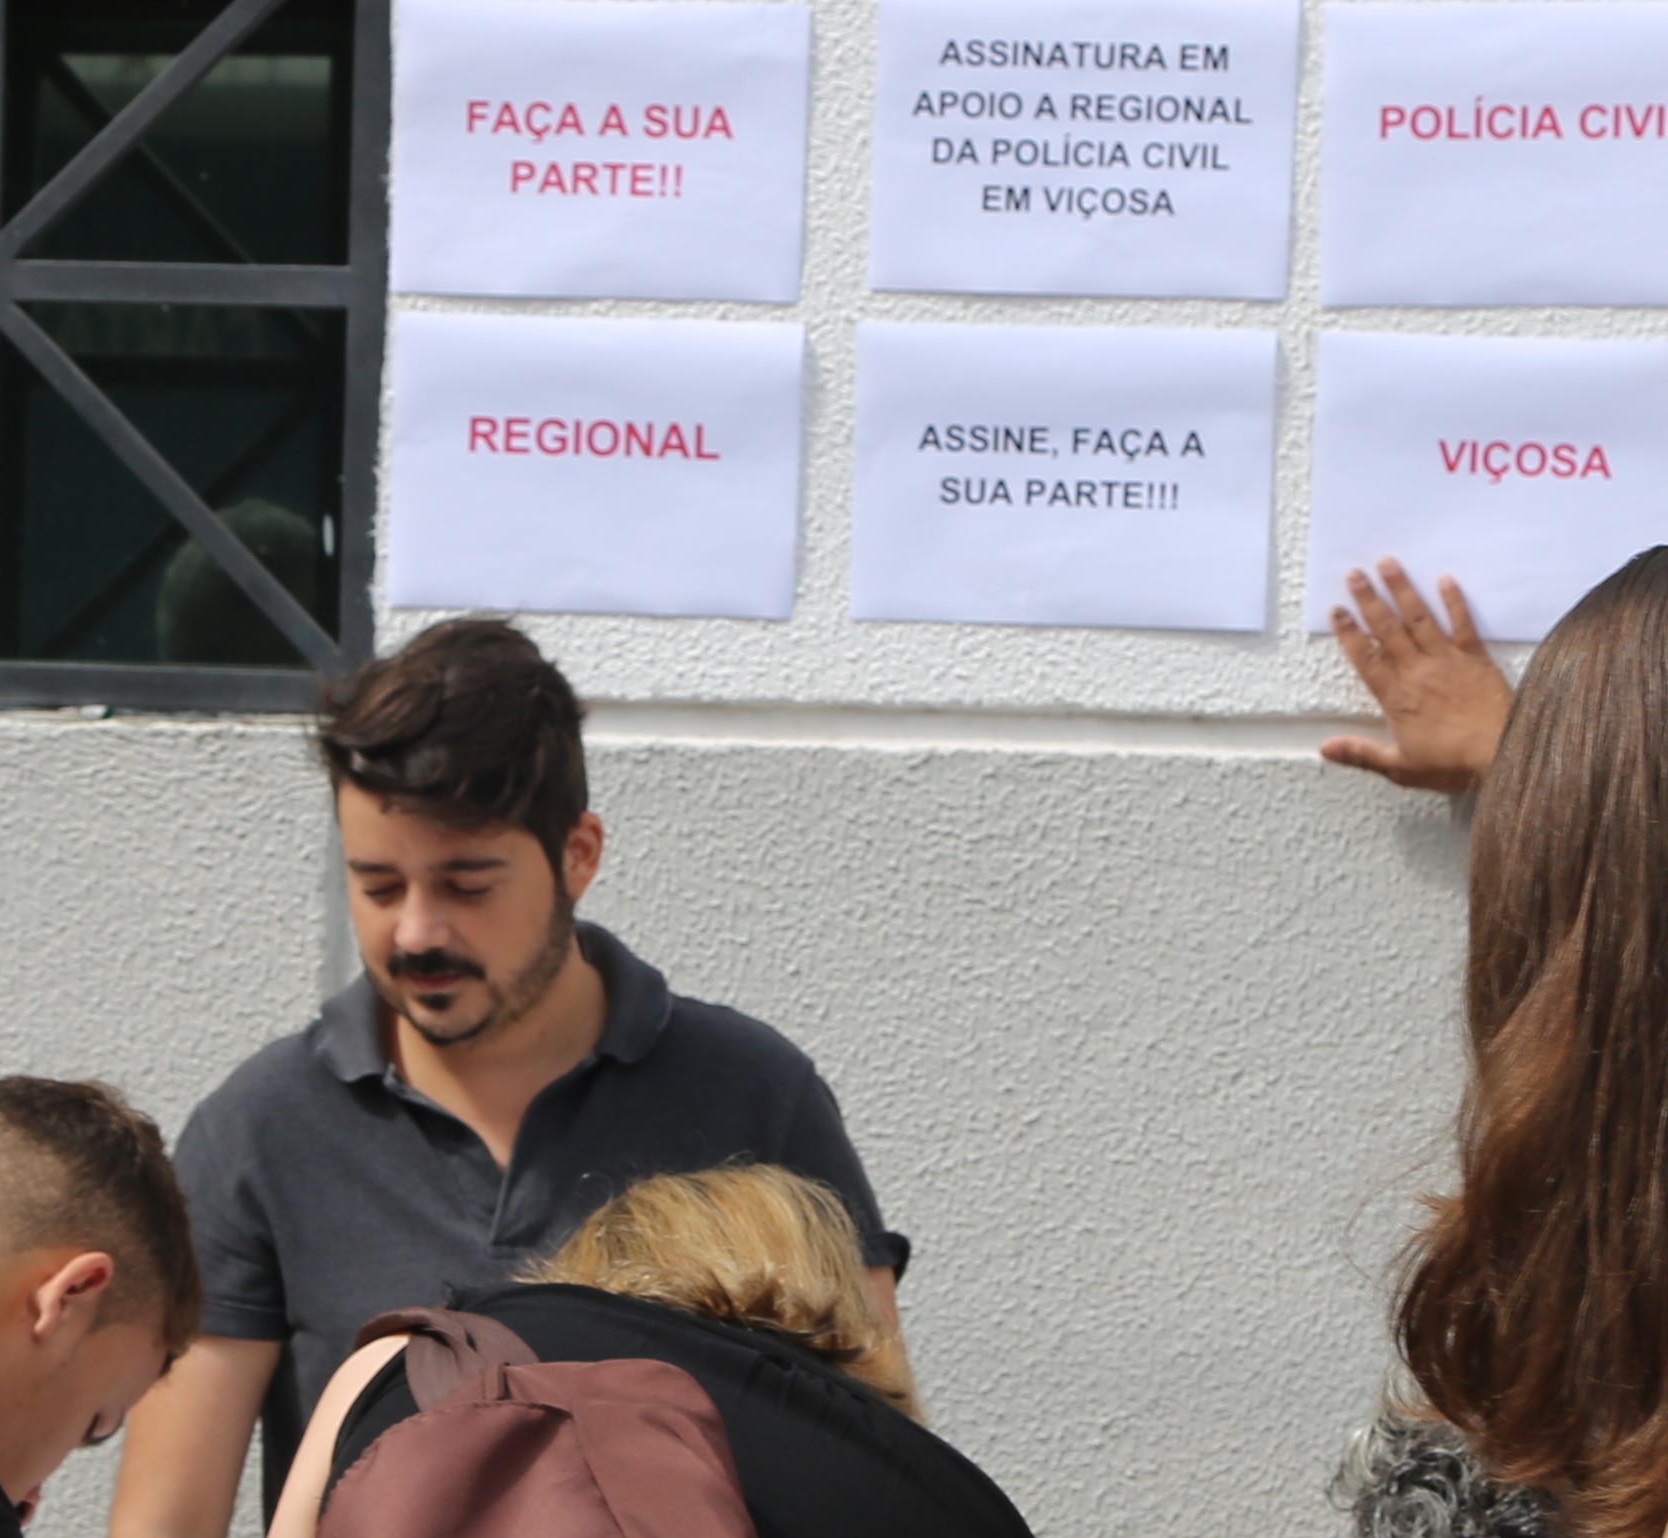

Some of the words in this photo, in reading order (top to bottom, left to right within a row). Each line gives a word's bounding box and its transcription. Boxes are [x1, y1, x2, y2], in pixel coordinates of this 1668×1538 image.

[938, 38, 1168, 71] ASSINATURA
[1178, 43, 1230, 72] EM
[466, 99, 585, 142] FAÇA
[597, 102, 630, 137] A
[642, 104, 734, 140] SUA
[911, 89, 1025, 120] APOIO
[1033, 92, 1059, 120] A
[1069, 93, 1253, 125] REGIONAL
[1379, 96, 1564, 141] POLÍCIA
[931, 135, 980, 165] DA
[990, 131, 1132, 169] POLÍCIA
[1142, 142, 1230, 171] CIVIL
[510, 159, 684, 197] PARTE!!
[981, 184, 1032, 213] EM
[1042, 186, 1176, 219] VIÇOSA
[468, 415, 721, 462] REGIONAL
[917, 422, 1059, 458] ASSINE,
[1071, 425, 1170, 463] FAÇA
[1179, 429, 1206, 458] A
[1437, 438, 1612, 484] VIÇOSA
[938, 475, 1016, 506] SUA
[1024, 478, 1180, 510] PARTE!!!
